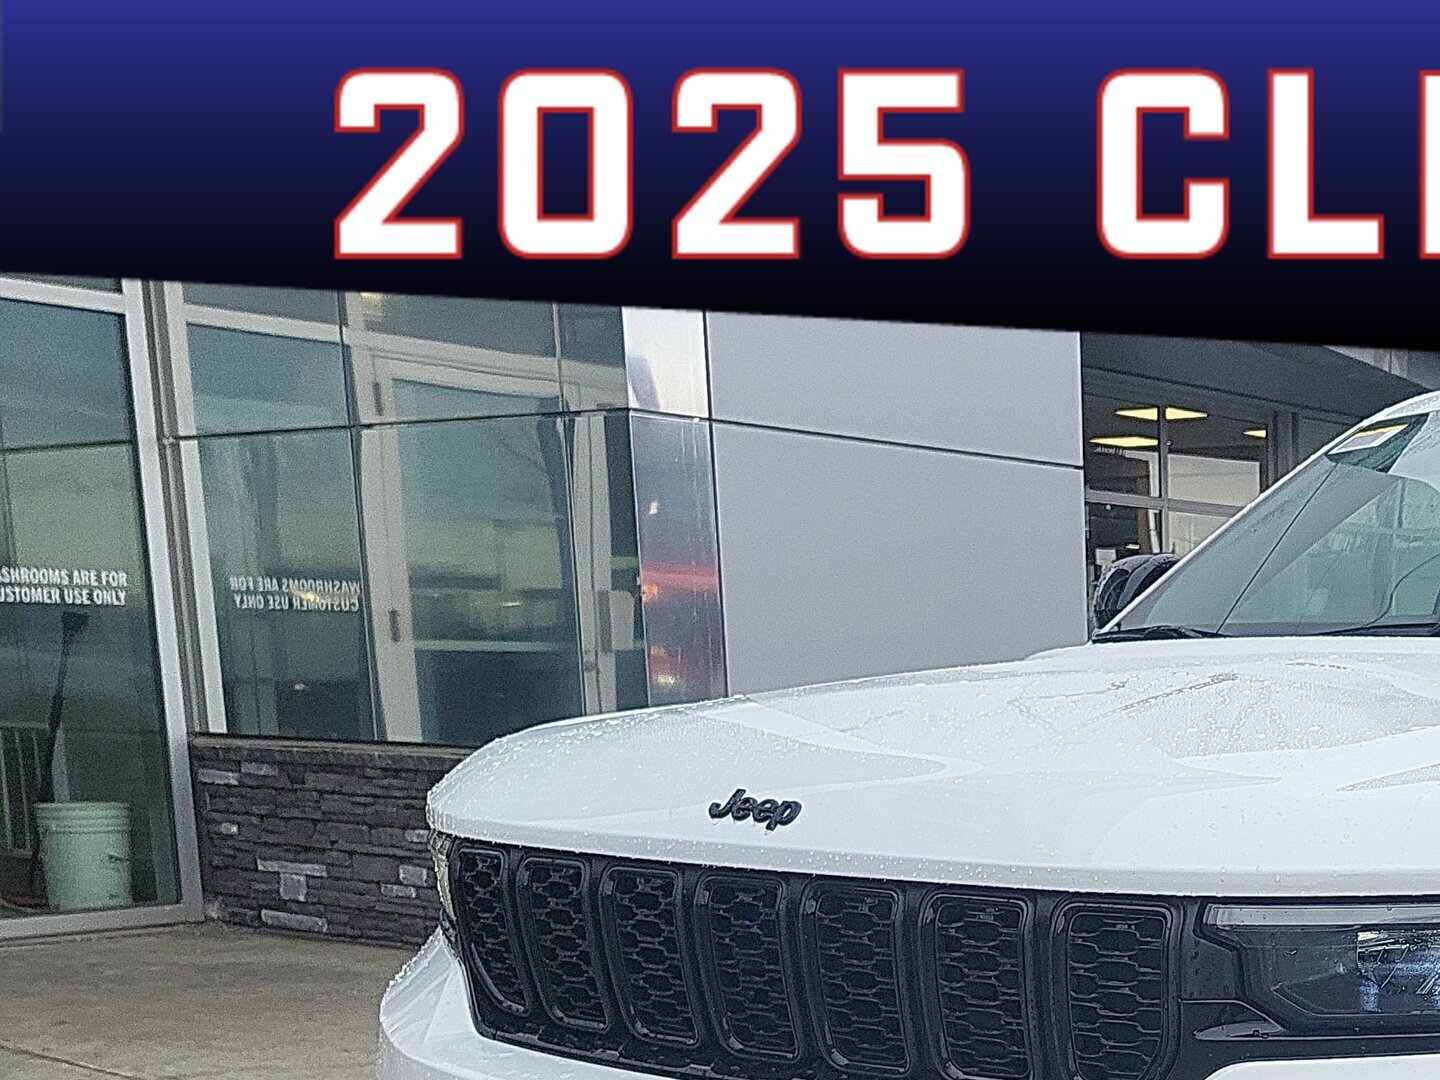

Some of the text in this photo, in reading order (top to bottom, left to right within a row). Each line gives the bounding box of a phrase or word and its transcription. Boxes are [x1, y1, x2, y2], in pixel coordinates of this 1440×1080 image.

[0, 566, 127, 587] SHROOMS ARE FOR
[64, 587, 91, 605] USE
[93, 588, 126, 606] ONLY
[708, 788, 802, 832] Jeep
